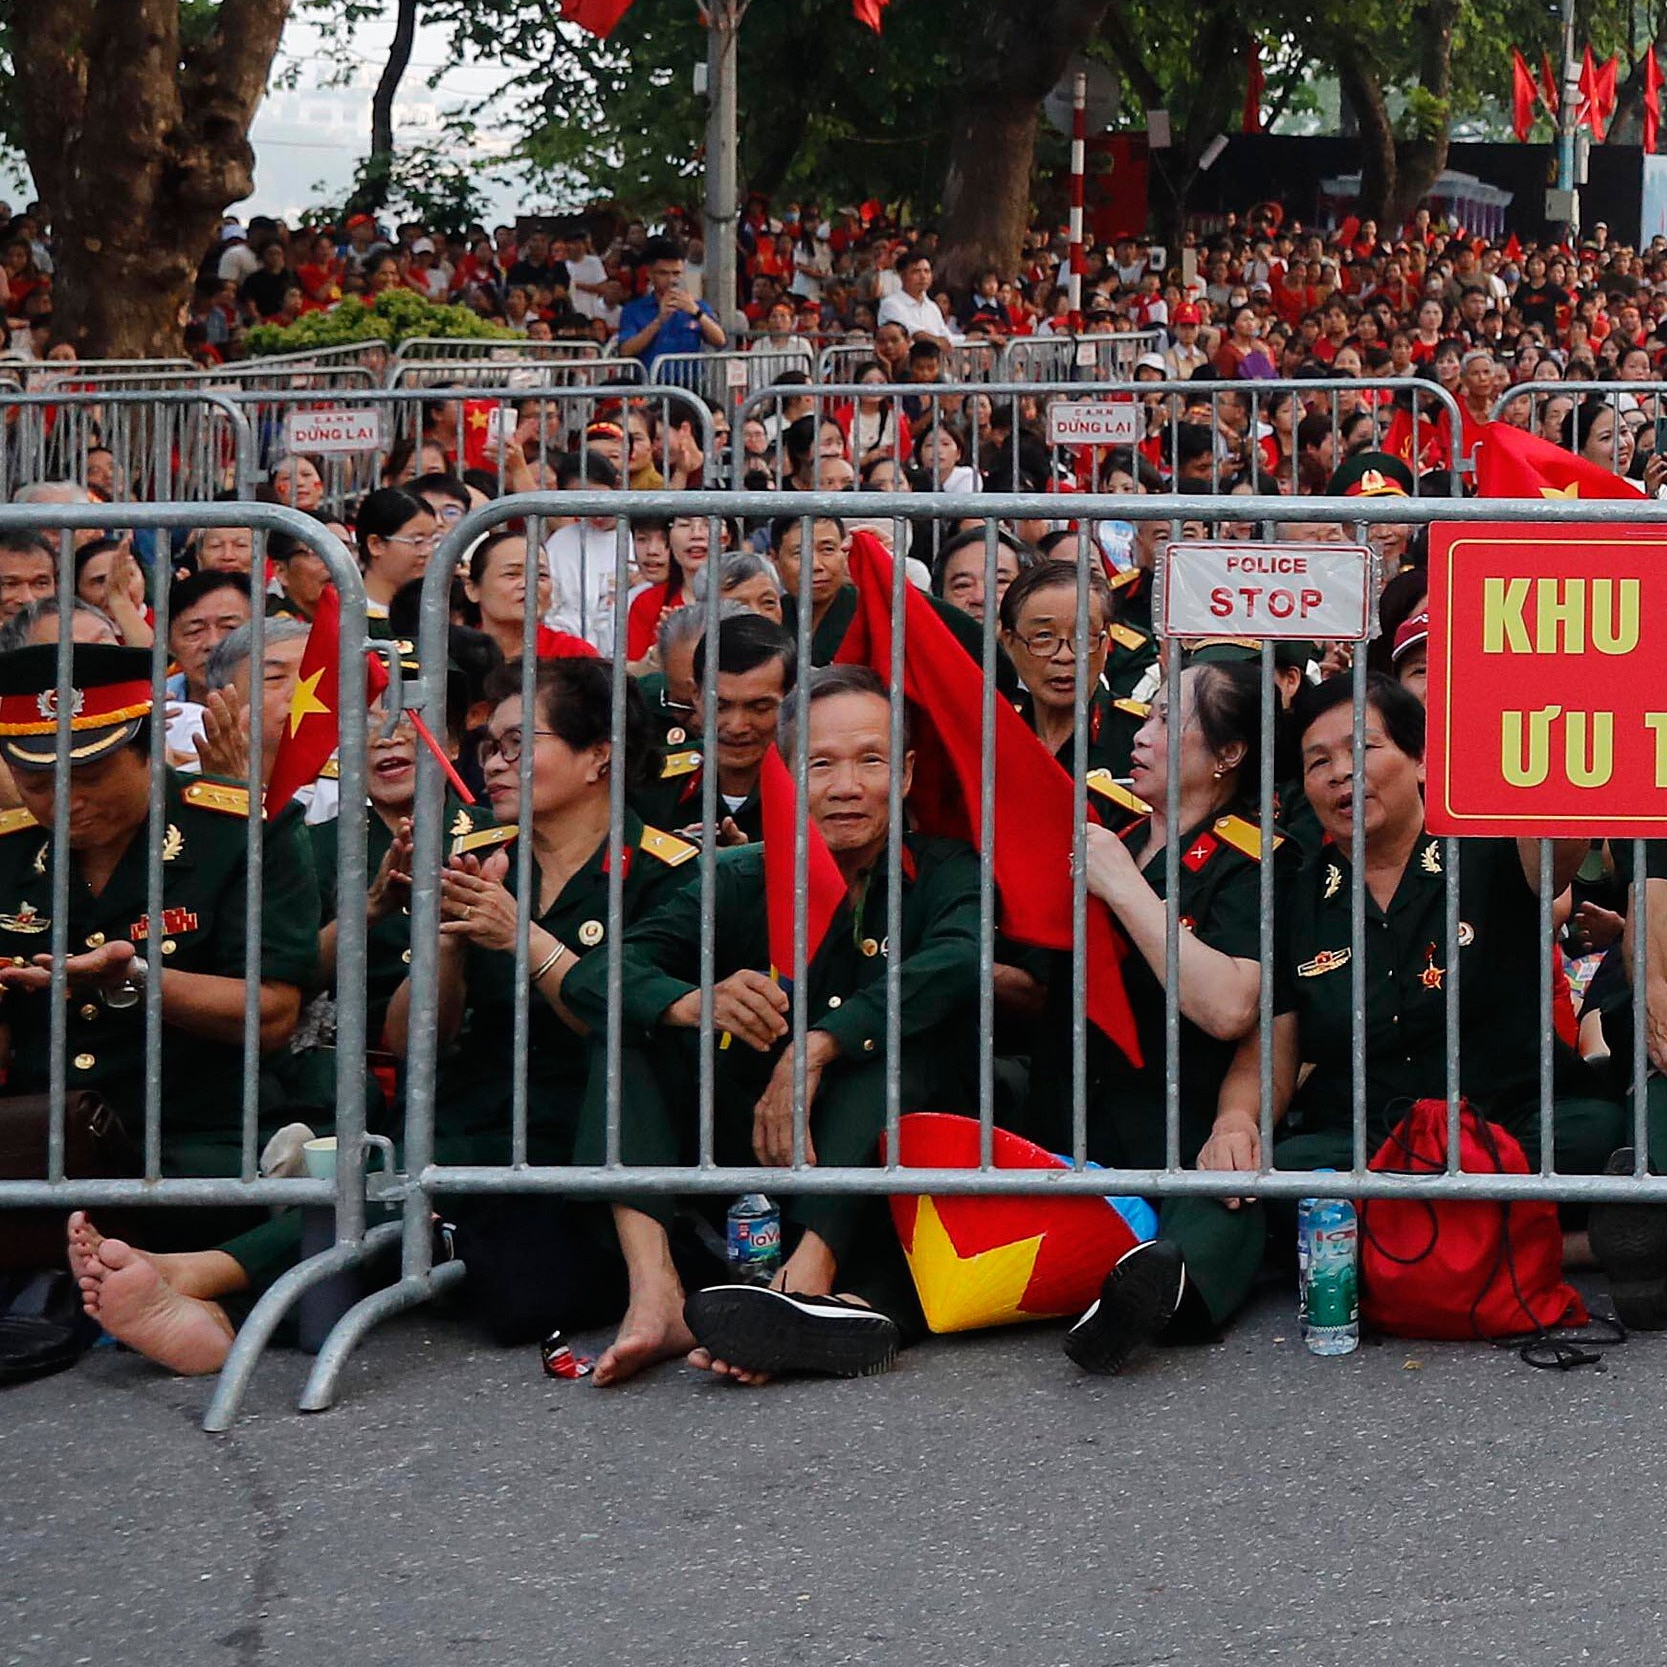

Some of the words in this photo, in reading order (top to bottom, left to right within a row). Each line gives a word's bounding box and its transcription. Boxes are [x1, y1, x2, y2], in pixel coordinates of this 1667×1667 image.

[1227, 557, 1307, 574] POLICE
[1211, 587, 1323, 619] STOP
[1483, 578, 1640, 655] KHU
[1501, 705, 1614, 788] ƯU
